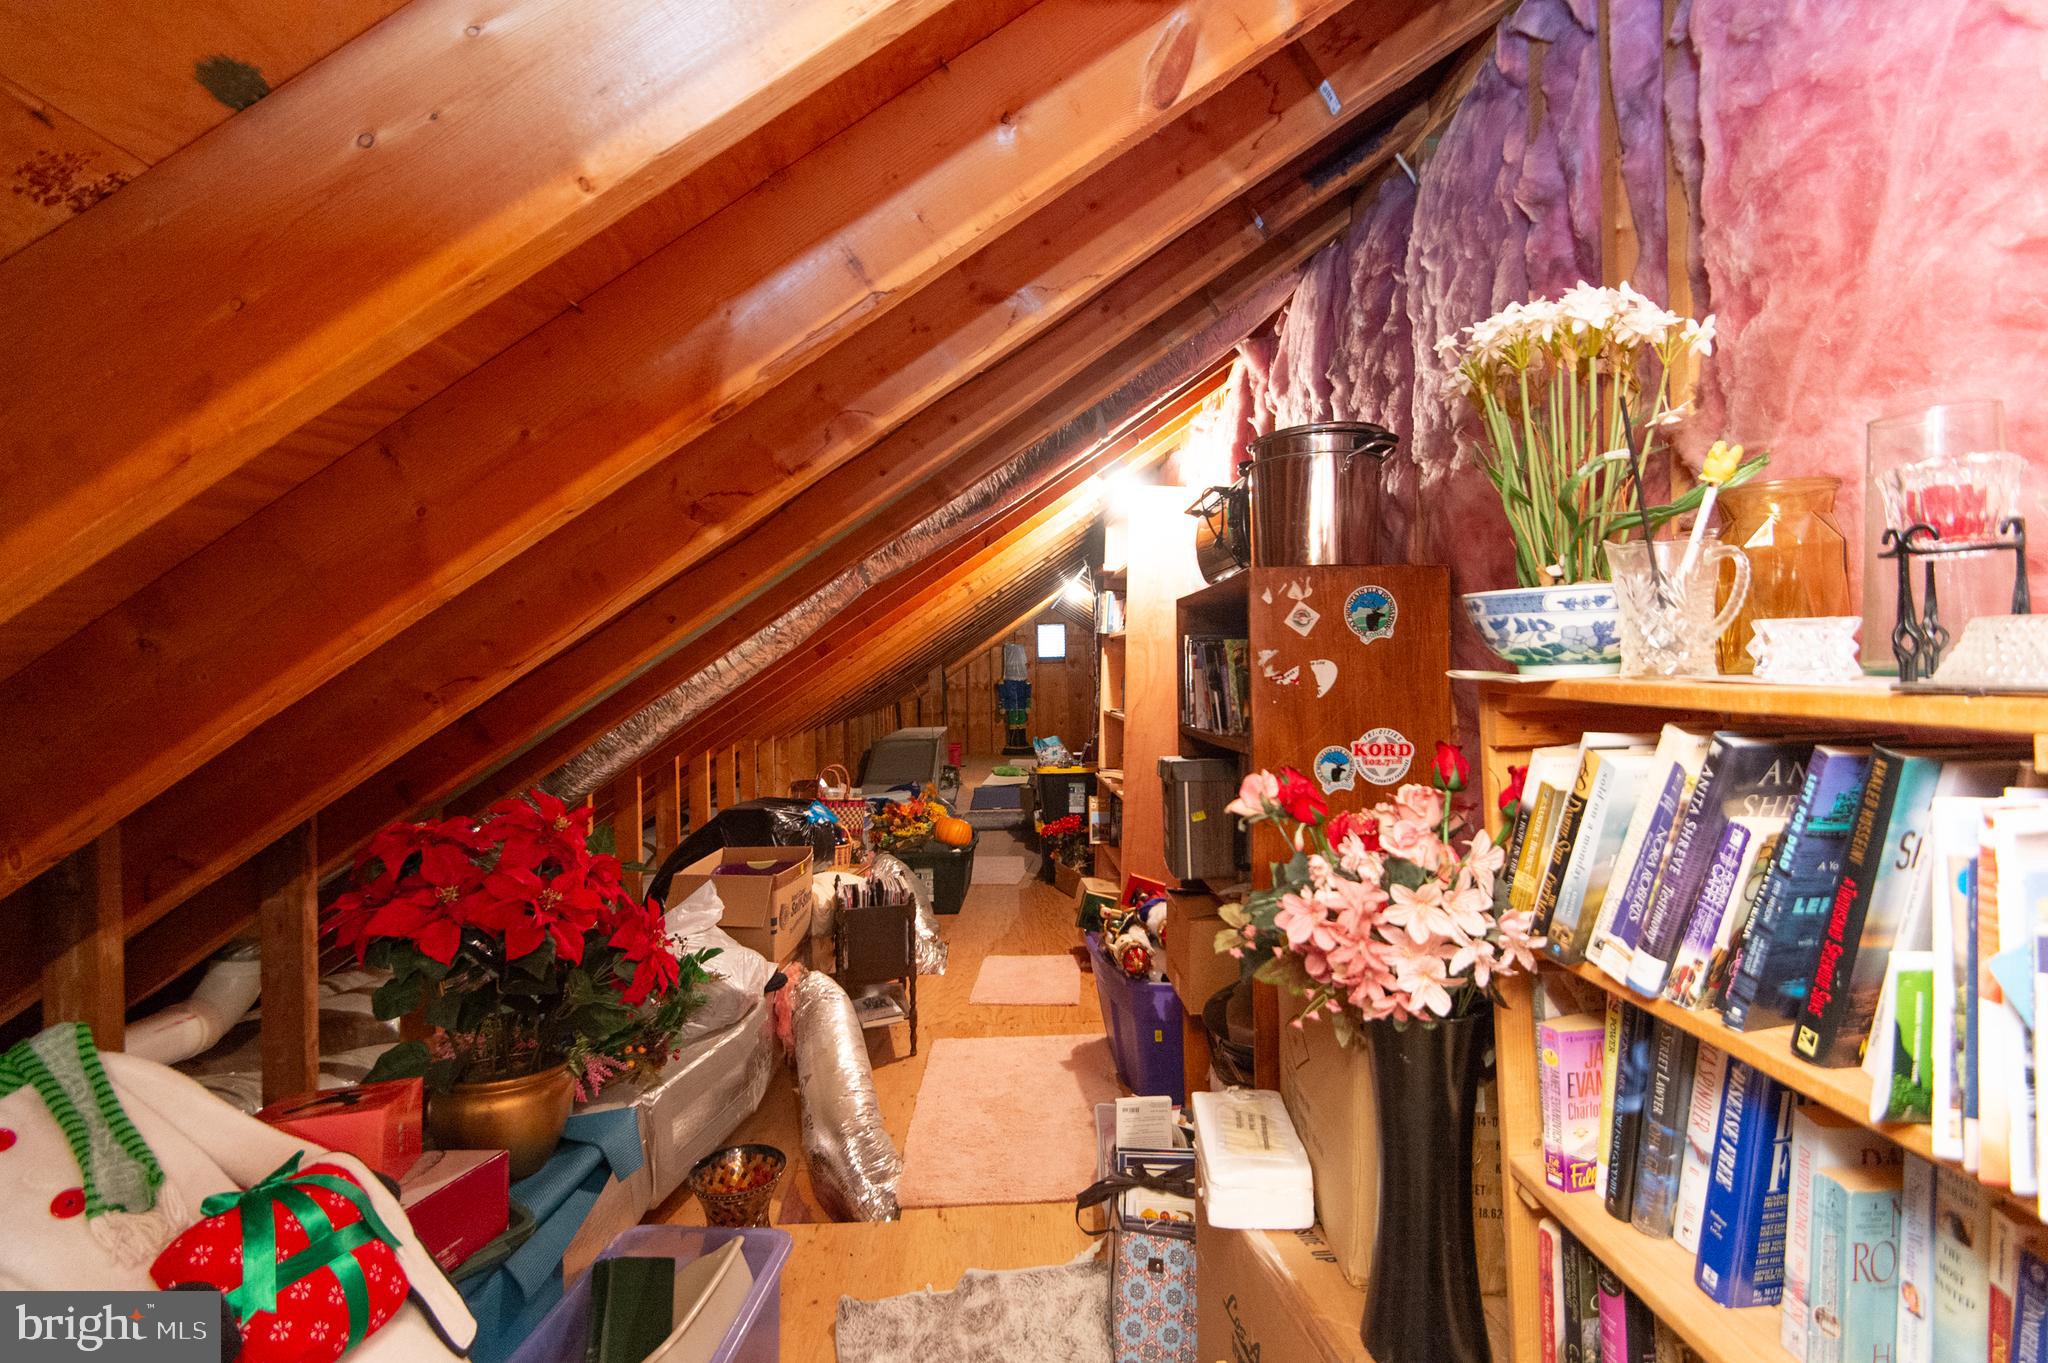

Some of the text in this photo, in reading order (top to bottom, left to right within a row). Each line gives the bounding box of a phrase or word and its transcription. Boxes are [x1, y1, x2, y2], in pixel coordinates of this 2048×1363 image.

[1354, 744, 1411, 756] KORD
[1517, 818, 1526, 841] HOPE
[1559, 796, 1581, 839] DANIELLE
[1573, 771, 1609, 880] sold on a monday
[1669, 765, 1714, 876] ANITA SHREVE
[1779, 774, 1816, 870] LEFT FOR DEAD
[1850, 759, 1887, 865] KHALED HOSSEINI
[1514, 843, 1521, 855] IN
[1524, 804, 1547, 869] SANDRA BROWN
[1552, 840, 1571, 866] STEEL
[1647, 824, 1667, 867] NORA
[1510, 856, 1518, 872] THE
[1702, 864, 1722, 901] CARR
[1817, 861, 1826, 871] A
[1537, 871, 1555, 920] COTTAGE
[1628, 869, 1653, 922] ROBERTS
[1711, 869, 1735, 911] ROBYN
[1763, 894, 1776, 922] NELSON
[1646, 883, 1674, 944] Testimony
[1687, 908, 1704, 945] DREAMS
[1807, 876, 1857, 1018] A THOUSAND SPLENDID SUNS
[1608, 1016, 1617, 1053] POWER
[1652, 1032, 1672, 1115] STREET LAWYER
[1553, 1095, 1563, 1144] EVANOVICH
[1690, 1069, 1713, 1133] SPINDLER
[1722, 1066, 1747, 1143] DISEASE
[1571, 1163, 1597, 1188] Full
[1714, 1137, 1737, 1192] FREE
[1797, 1145, 1810, 1187] DAVID
[1793, 1190, 1808, 1251] BALDACCI
[1312, 1250, 1338, 1263] UP
[1852, 1241, 1896, 1283] RO
